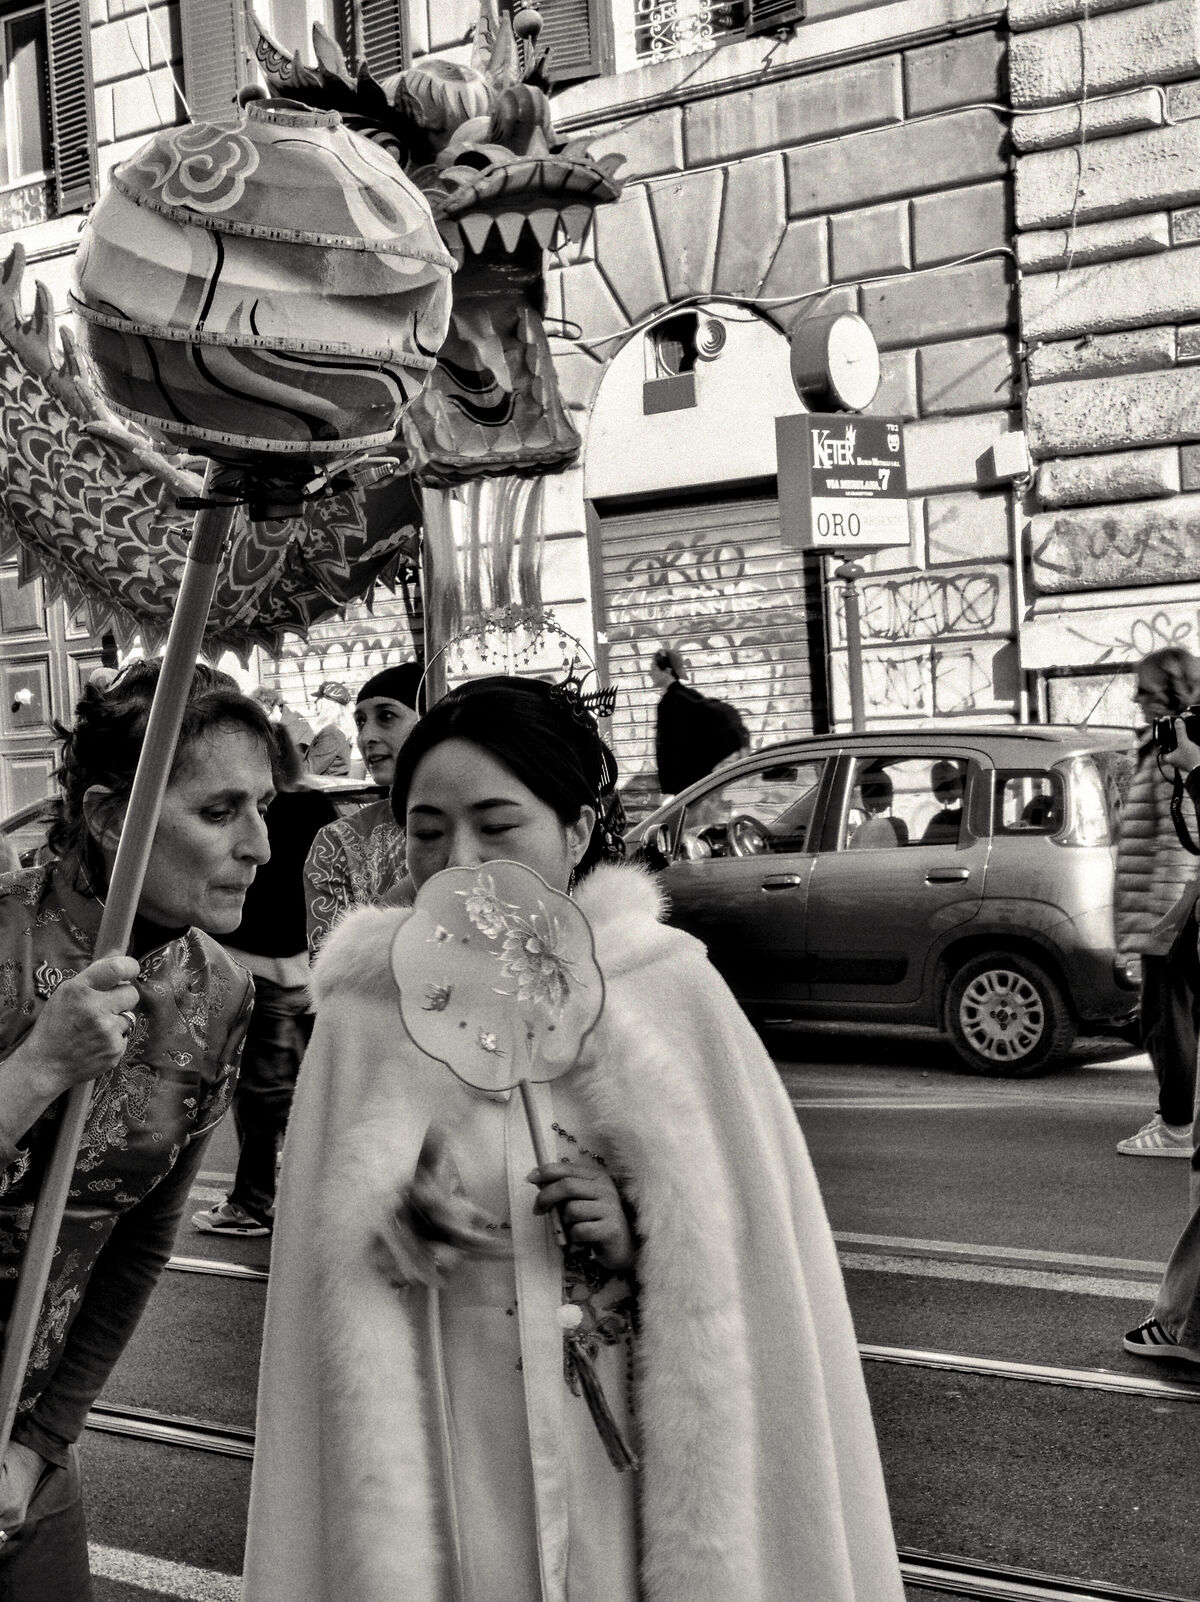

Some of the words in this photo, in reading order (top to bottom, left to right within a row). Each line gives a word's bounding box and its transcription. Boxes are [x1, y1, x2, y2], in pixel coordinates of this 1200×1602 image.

[811, 429, 855, 469] KETER
[825, 479, 840, 489] VIA
[878, 468, 891, 491] 7
[817, 512, 861, 537] ORO
